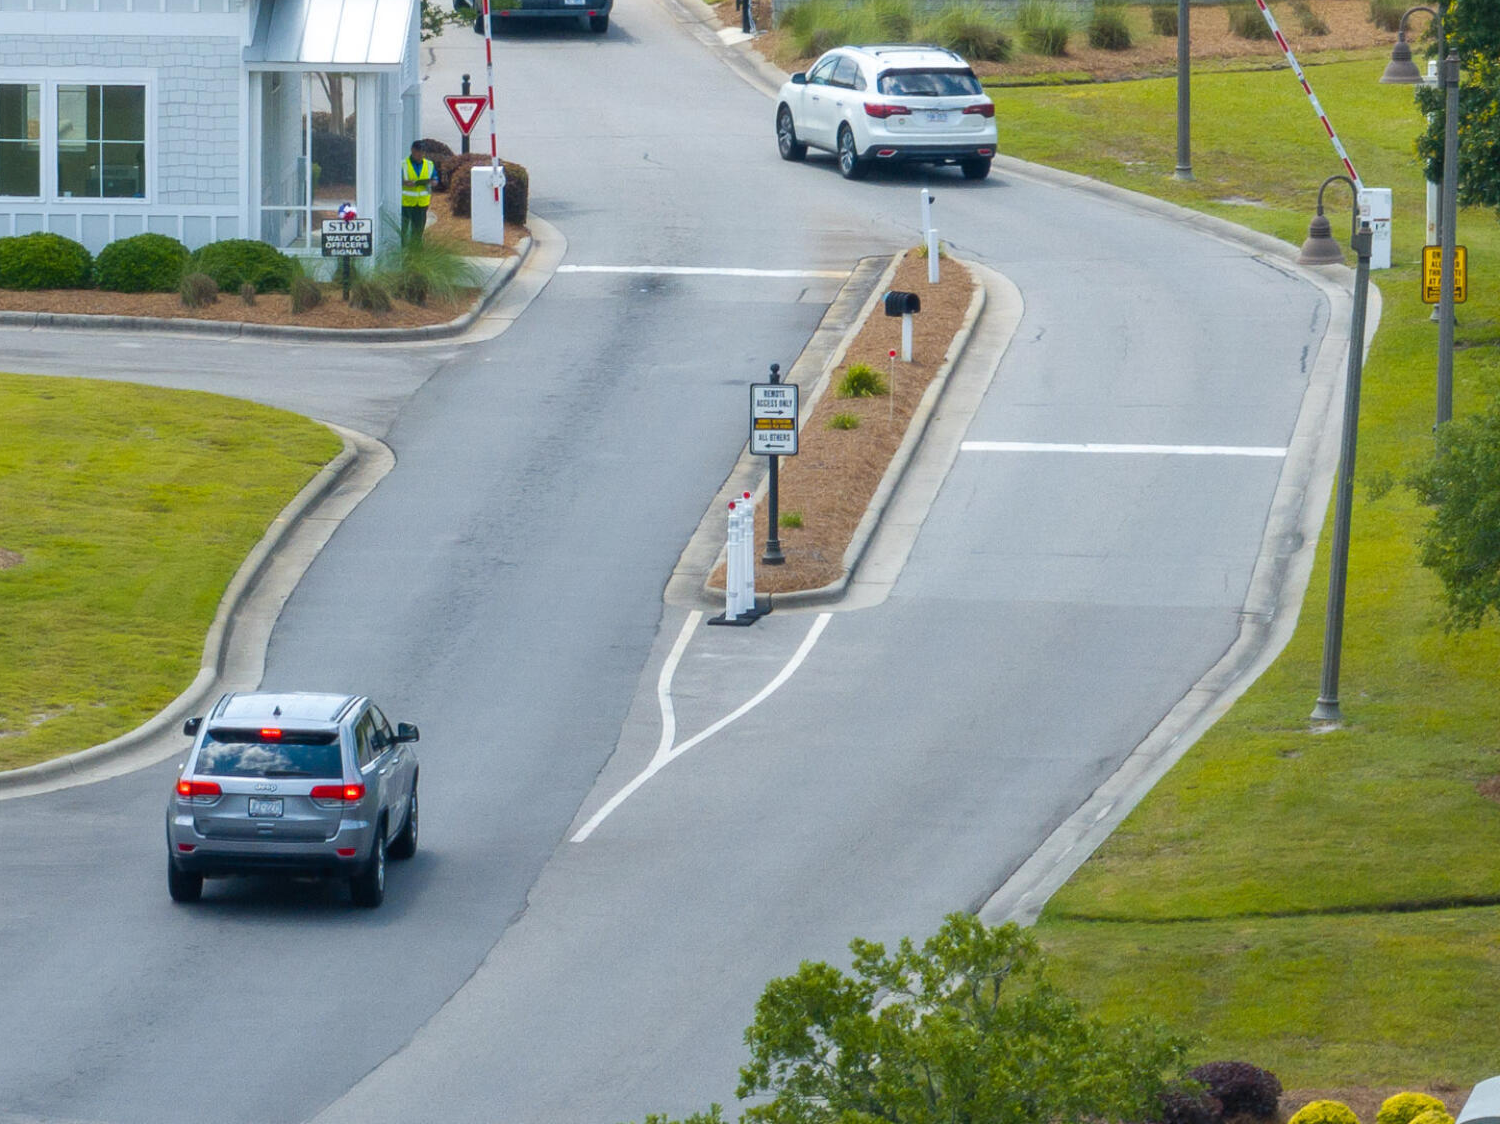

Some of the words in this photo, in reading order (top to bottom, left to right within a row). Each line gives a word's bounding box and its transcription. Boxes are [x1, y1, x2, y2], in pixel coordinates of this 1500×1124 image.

[328, 221, 364, 232] STOP
[757, 399, 777, 407] ACCESS
[779, 399, 792, 407] ONLY
[255, 783, 277, 792] Jeep
